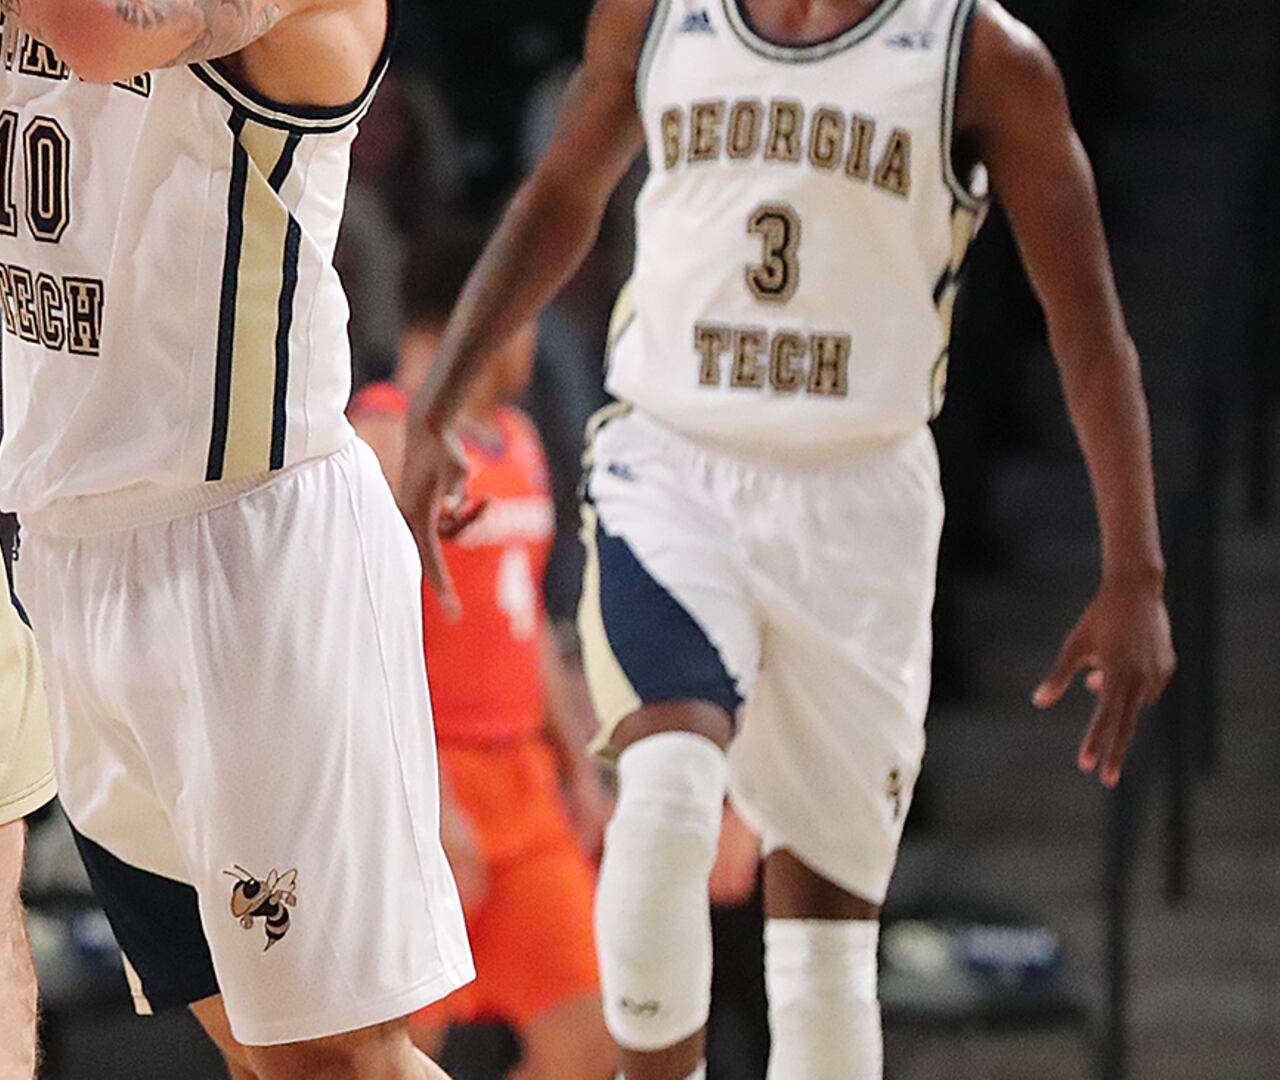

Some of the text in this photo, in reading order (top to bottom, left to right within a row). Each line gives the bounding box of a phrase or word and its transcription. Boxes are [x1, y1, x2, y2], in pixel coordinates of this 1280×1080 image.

[661, 95, 912, 201] GEORGIA
[745, 200, 802, 303] 3
[694, 322, 852, 398] TECH
